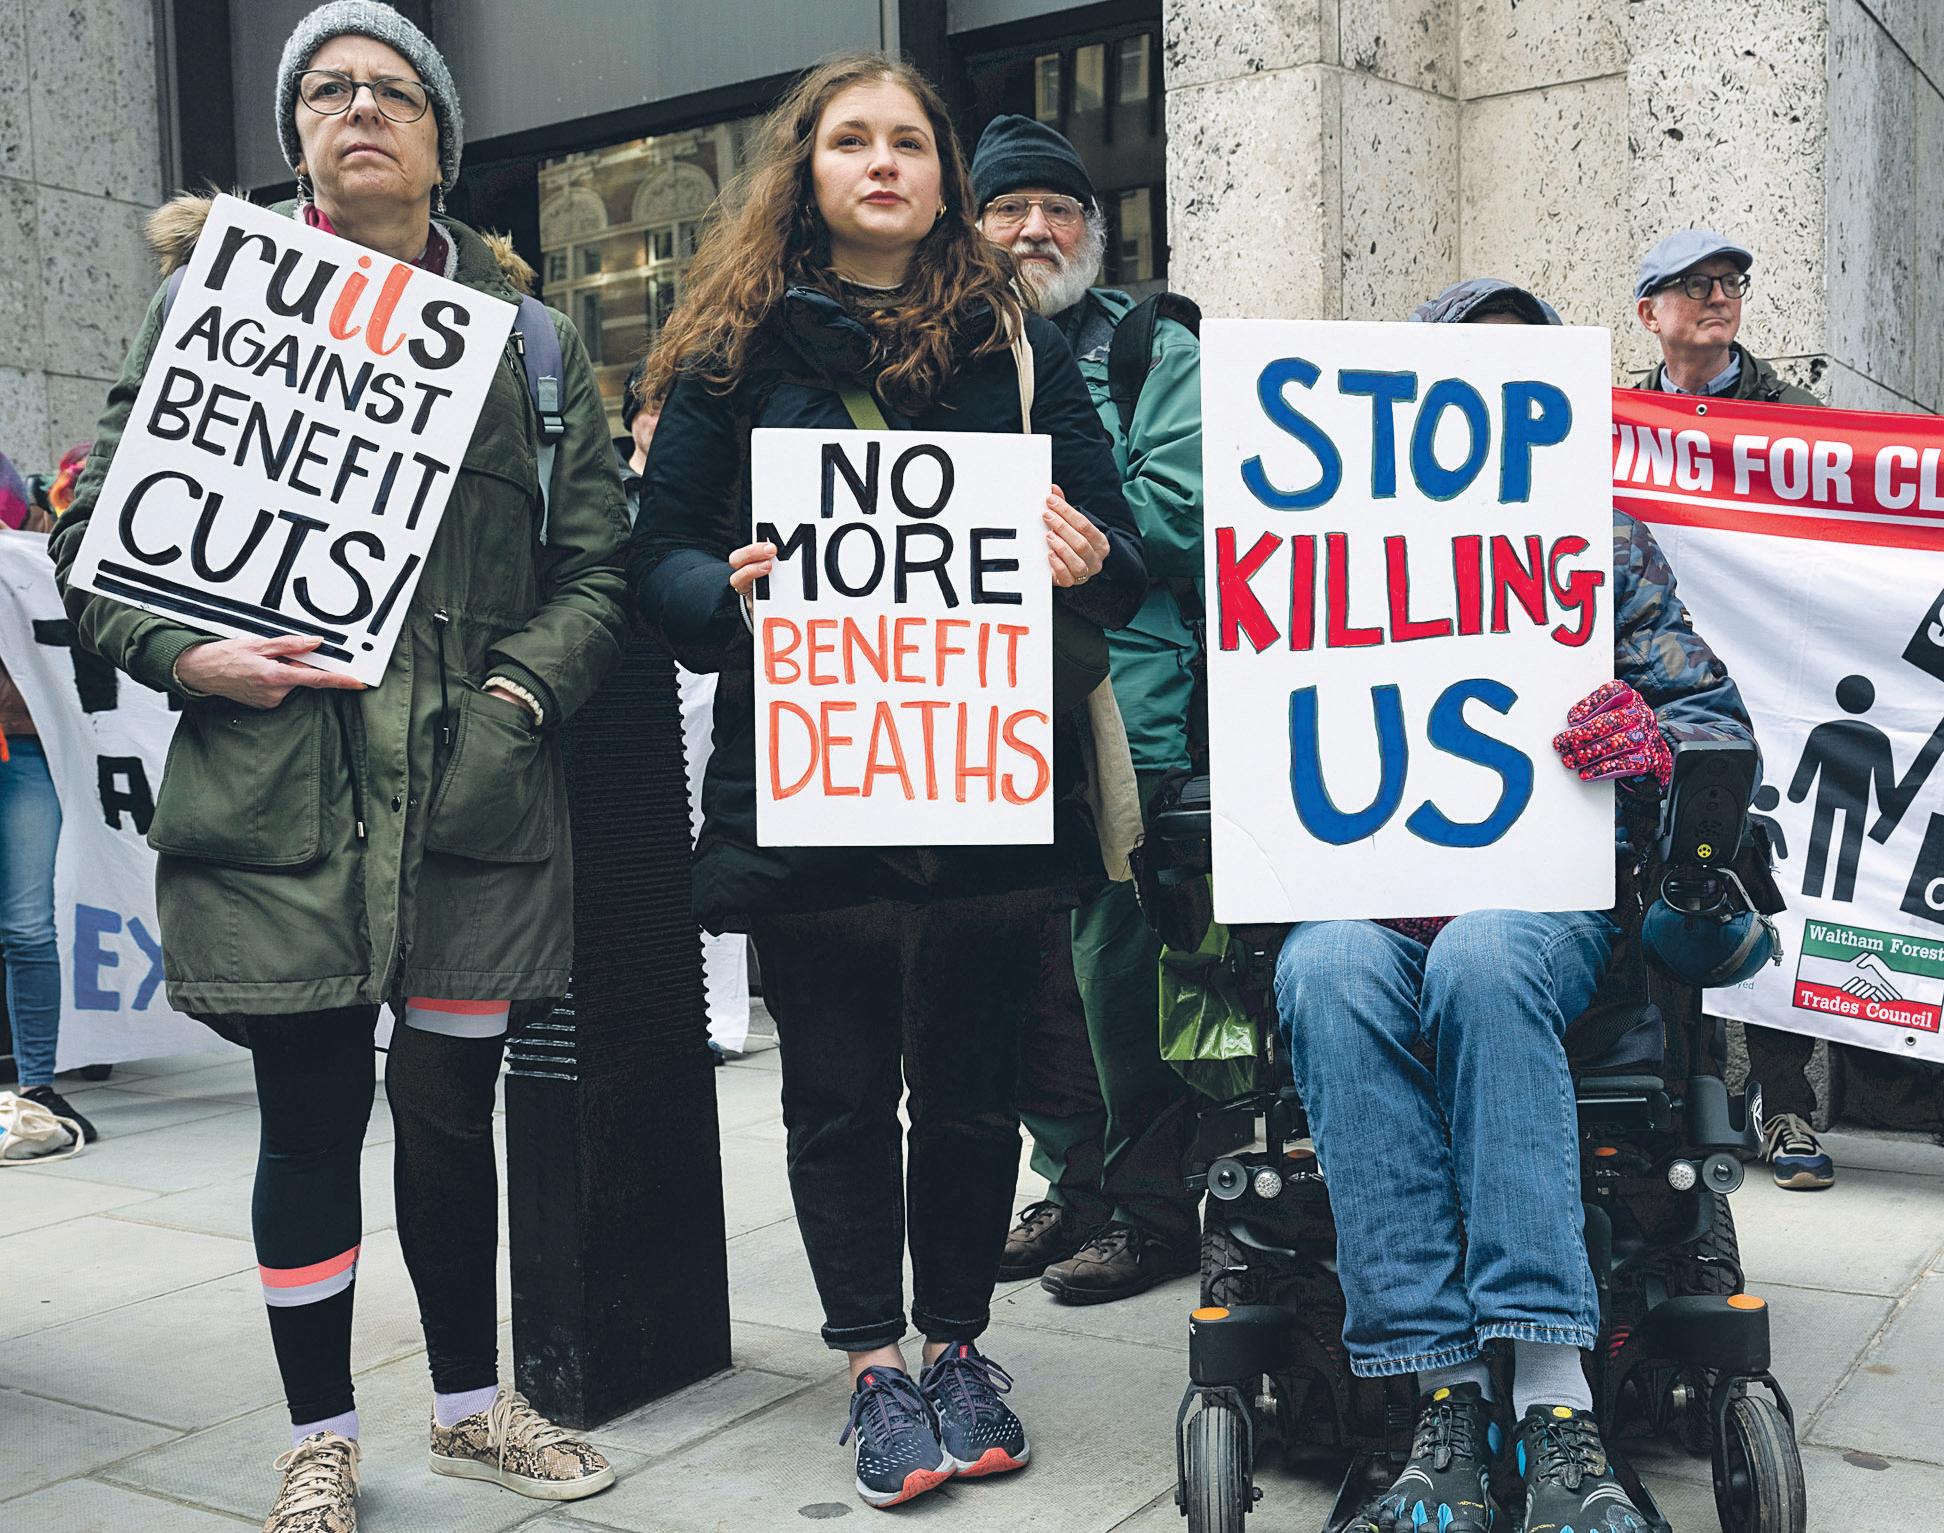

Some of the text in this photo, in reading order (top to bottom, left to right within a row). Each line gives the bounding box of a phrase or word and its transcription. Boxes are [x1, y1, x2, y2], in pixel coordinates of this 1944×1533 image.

[204, 226, 470, 370] ruils
[175, 305, 453, 435] AGAINST
[147, 366, 450, 530] BENEFIT
[821, 441, 955, 519] NO
[1240, 356, 1572, 511] STOP
[1612, 423, 1714, 492] ING
[1732, 434, 1854, 504] FOR
[118, 470, 421, 651] CUTS!
[756, 521, 1023, 609] MORE
[1215, 526, 1605, 654] KILLING
[763, 615, 1029, 688] BENEFIT
[768, 700, 1051, 806] DEATHS
[1290, 677, 1535, 848] US
[1809, 924, 1944, 961] Waltham Forest
[1801, 990, 1933, 1028] Trades Council
